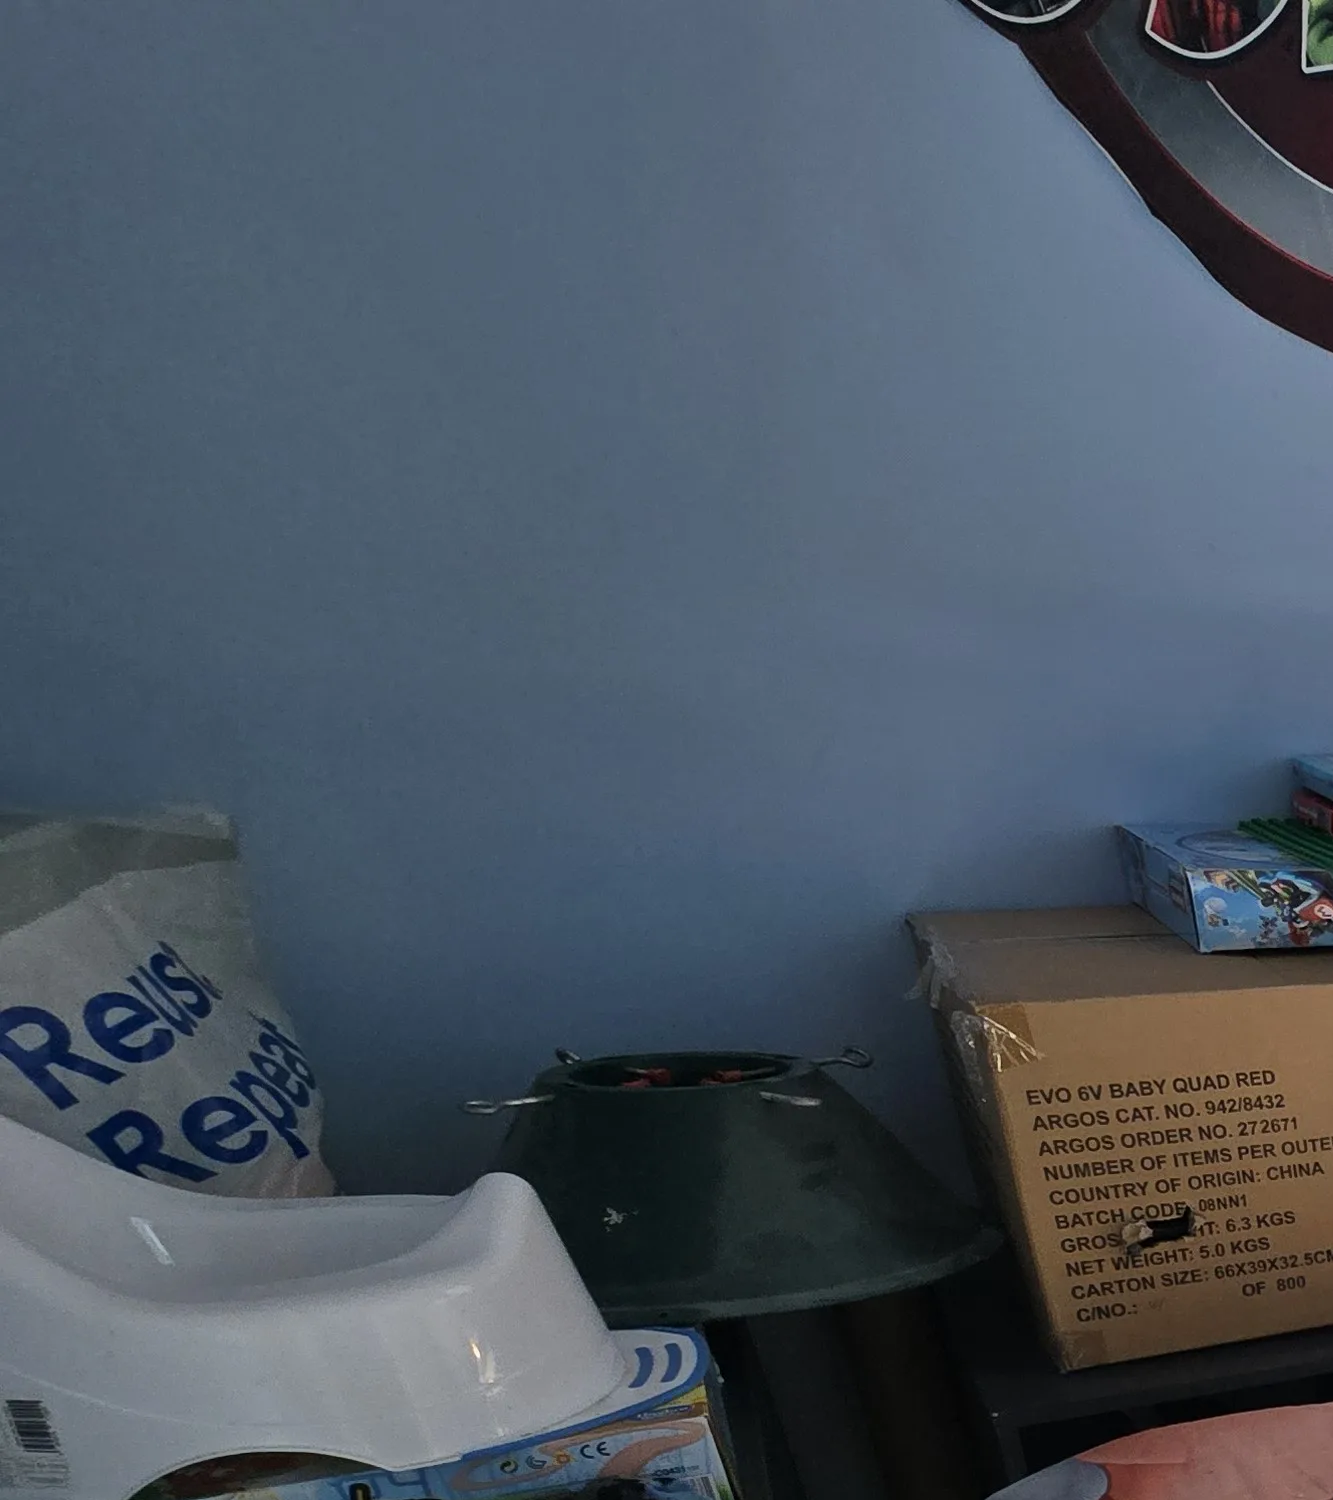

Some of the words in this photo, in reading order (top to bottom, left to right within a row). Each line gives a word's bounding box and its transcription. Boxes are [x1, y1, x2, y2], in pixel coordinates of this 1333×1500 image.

[1025, 1086, 1072, 1106] EVO
[1078, 1084, 1101, 1102] 6V
[1109, 1079, 1167, 1100] BABY
[1172, 1074, 1230, 1096] QUAD
[1235, 1069, 1276, 1089] RED
[1032, 1108, 1110, 1132] ARGOS
[1115, 1105, 1160, 1125] CAT.
[1164, 1102, 1201, 1119] NO.
[1205, 1093, 1286, 1115] 942/8432
[1038, 1134, 1115, 1157] ARGOS
[1120, 1127, 1194, 1149] ORDER
[1199, 1123, 1234, 1142] NO.
[1237, 1116, 1299, 1137] 272671
[1043, 1159, 1135, 1182] NUMBER
[1140, 1154, 1168, 1172] OF
[1173, 1147, 1233, 1168] ITEMS
[1238, 1143, 1276, 1162] PER
[1049, 1182, 1148, 1206] COUNTRY
[1155, 1178, 1182, 1197] OF
[1188, 1171, 1262, 1190] ORIGIN:
[1266, 1161, 1325, 1182] CHINA
[1055, 1207, 1126, 1230] BATCH
[1198, 1195, 1248, 1213] 08NN1
[1225, 1216, 1253, 1233] 6.3
[1256, 1210, 1296, 1229] KGS
[1065, 1259, 1106, 1278] NET
[1112, 1248, 1194, 1272] WEIGHT:
[1199, 1243, 1226, 1260] 5.0
[1230, 1237, 1271, 1255] KGS
[1071, 1277, 1156, 1300] CARTON
[1161, 1270, 1209, 1289] SIZE:
[1242, 1282, 1267, 1298] OF
[1276, 1275, 1306, 1293] 800
